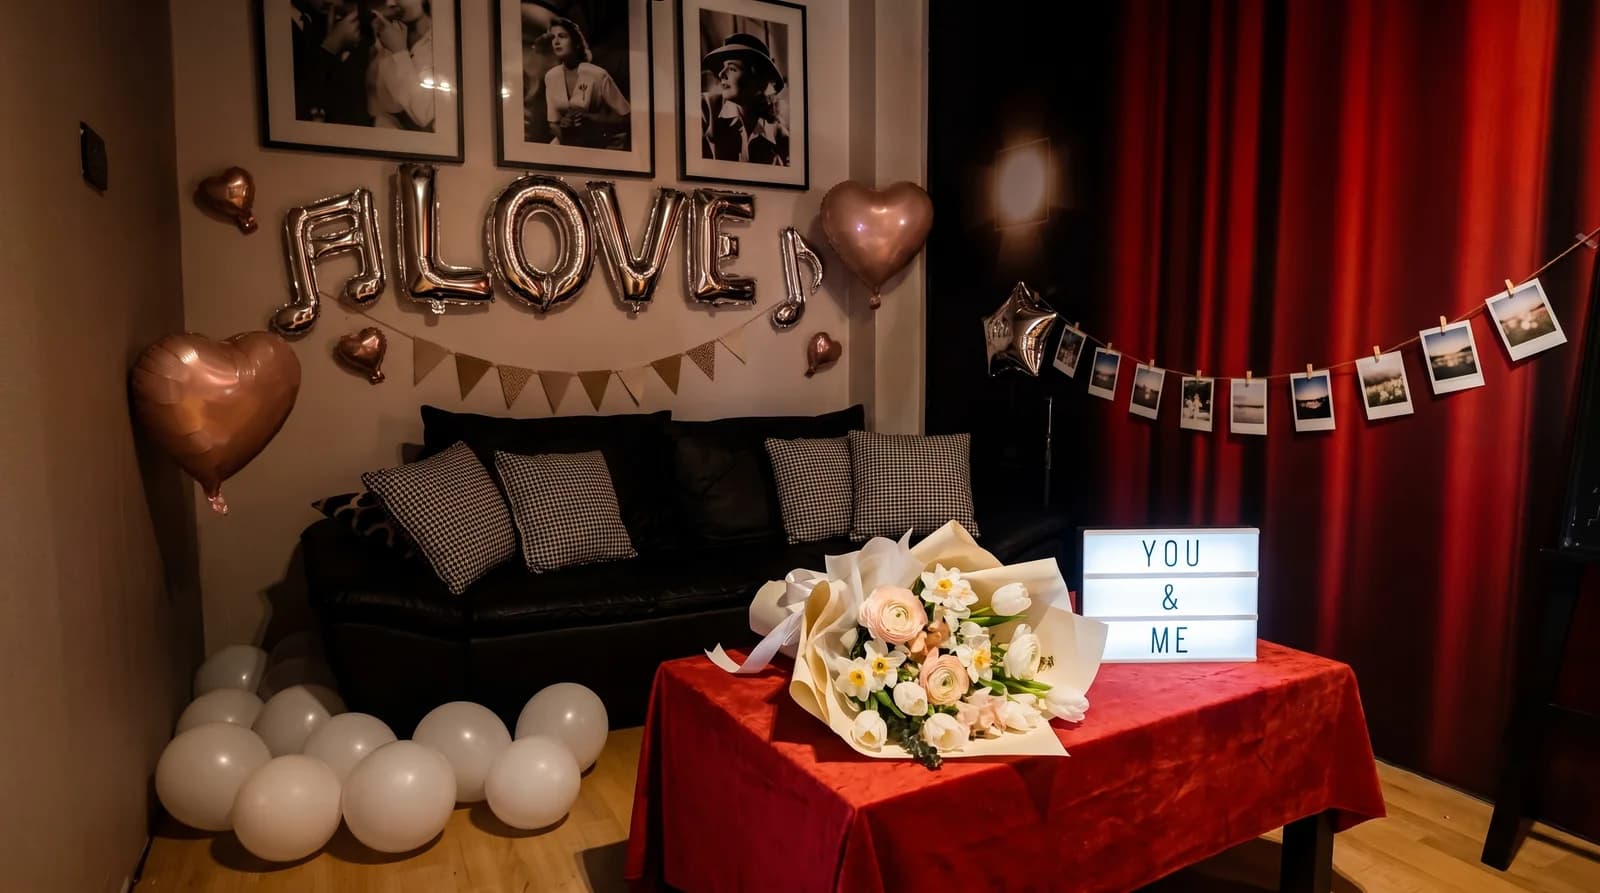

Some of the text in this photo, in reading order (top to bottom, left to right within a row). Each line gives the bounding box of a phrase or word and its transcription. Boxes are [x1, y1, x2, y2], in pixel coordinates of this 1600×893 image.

[396, 162, 757, 314] LOVE
[1142, 540, 1199, 567] YOU
[1162, 584, 1178, 610] &
[1151, 627, 1188, 653] ME
